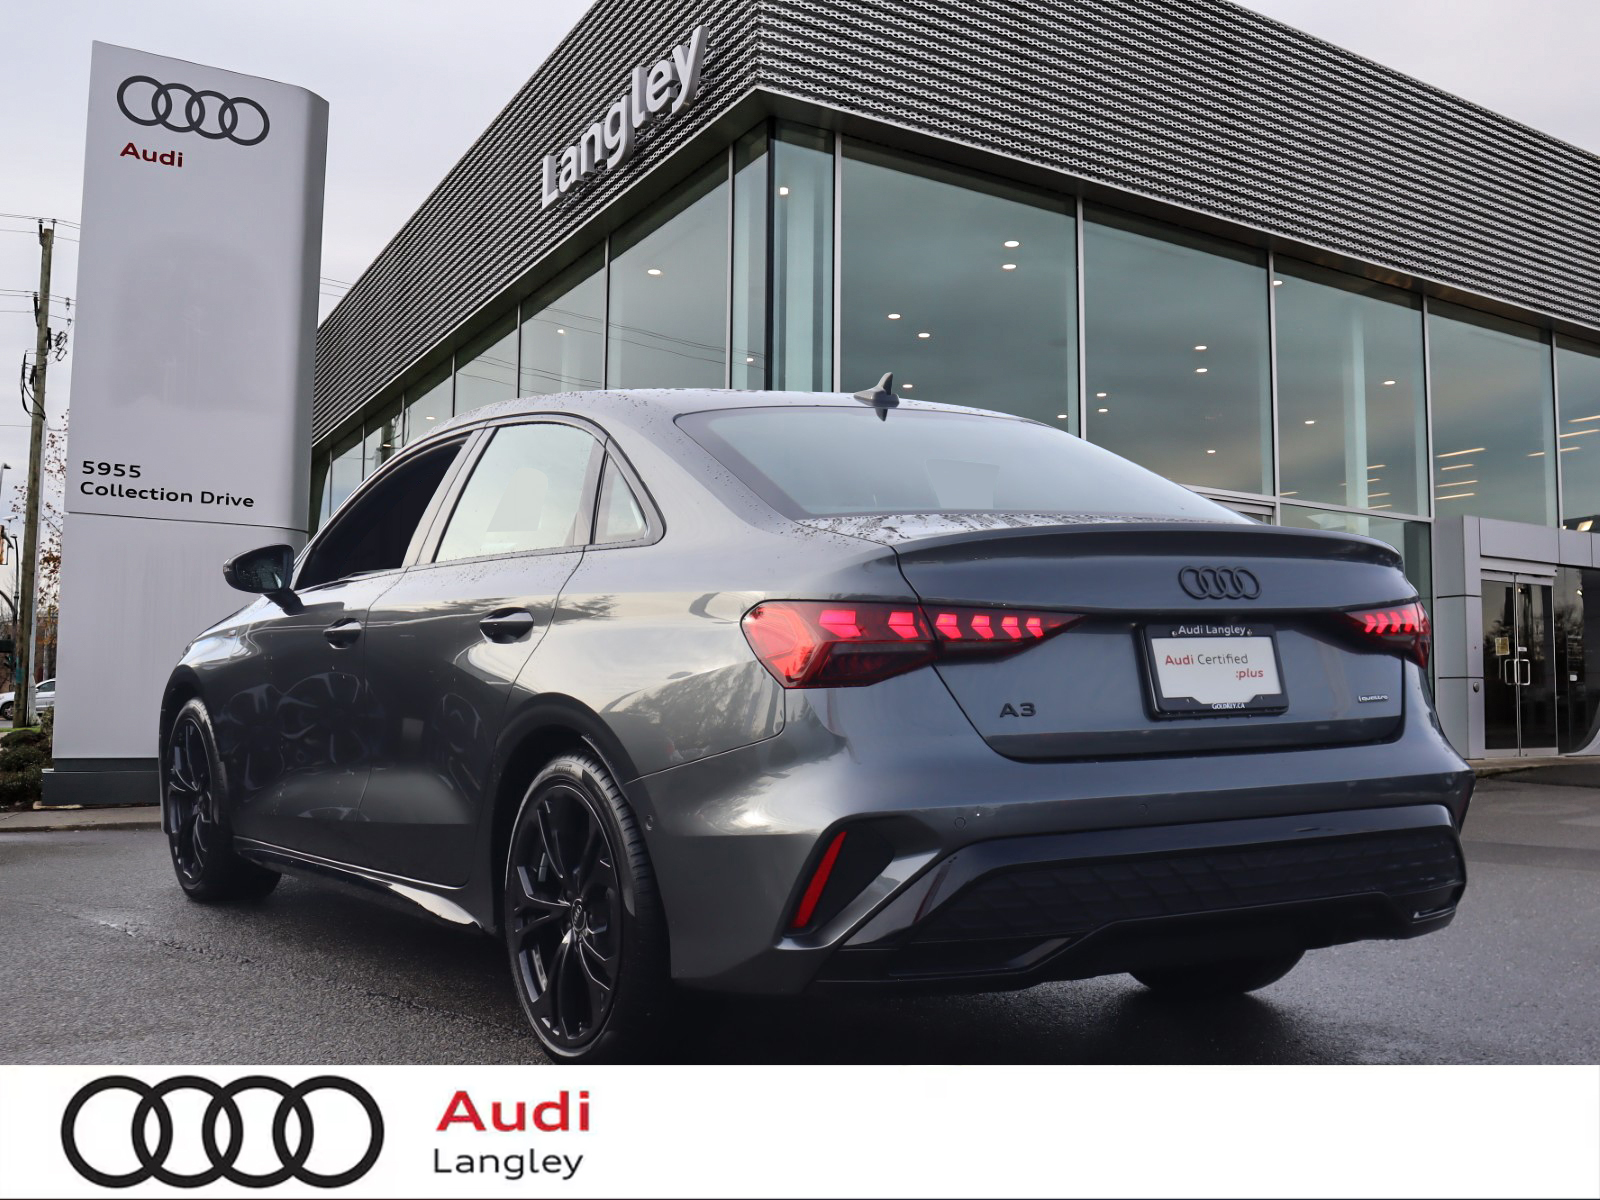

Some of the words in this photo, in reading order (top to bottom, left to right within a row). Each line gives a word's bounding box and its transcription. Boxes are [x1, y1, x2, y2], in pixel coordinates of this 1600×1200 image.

[541, 25, 710, 209] Langley
[119, 142, 184, 168] Audi
[81, 460, 141, 478] 5955
[80, 481, 193, 503] Collection
[200, 490, 255, 508] Drive
[1178, 625, 1203, 635] Audi
[1206, 625, 1246, 637] Langley
[1165, 654, 1194, 666] Audi
[1197, 653, 1248, 665] Certified
[1235, 668, 1264, 680] :plus
[999, 702, 1037, 718] A3
